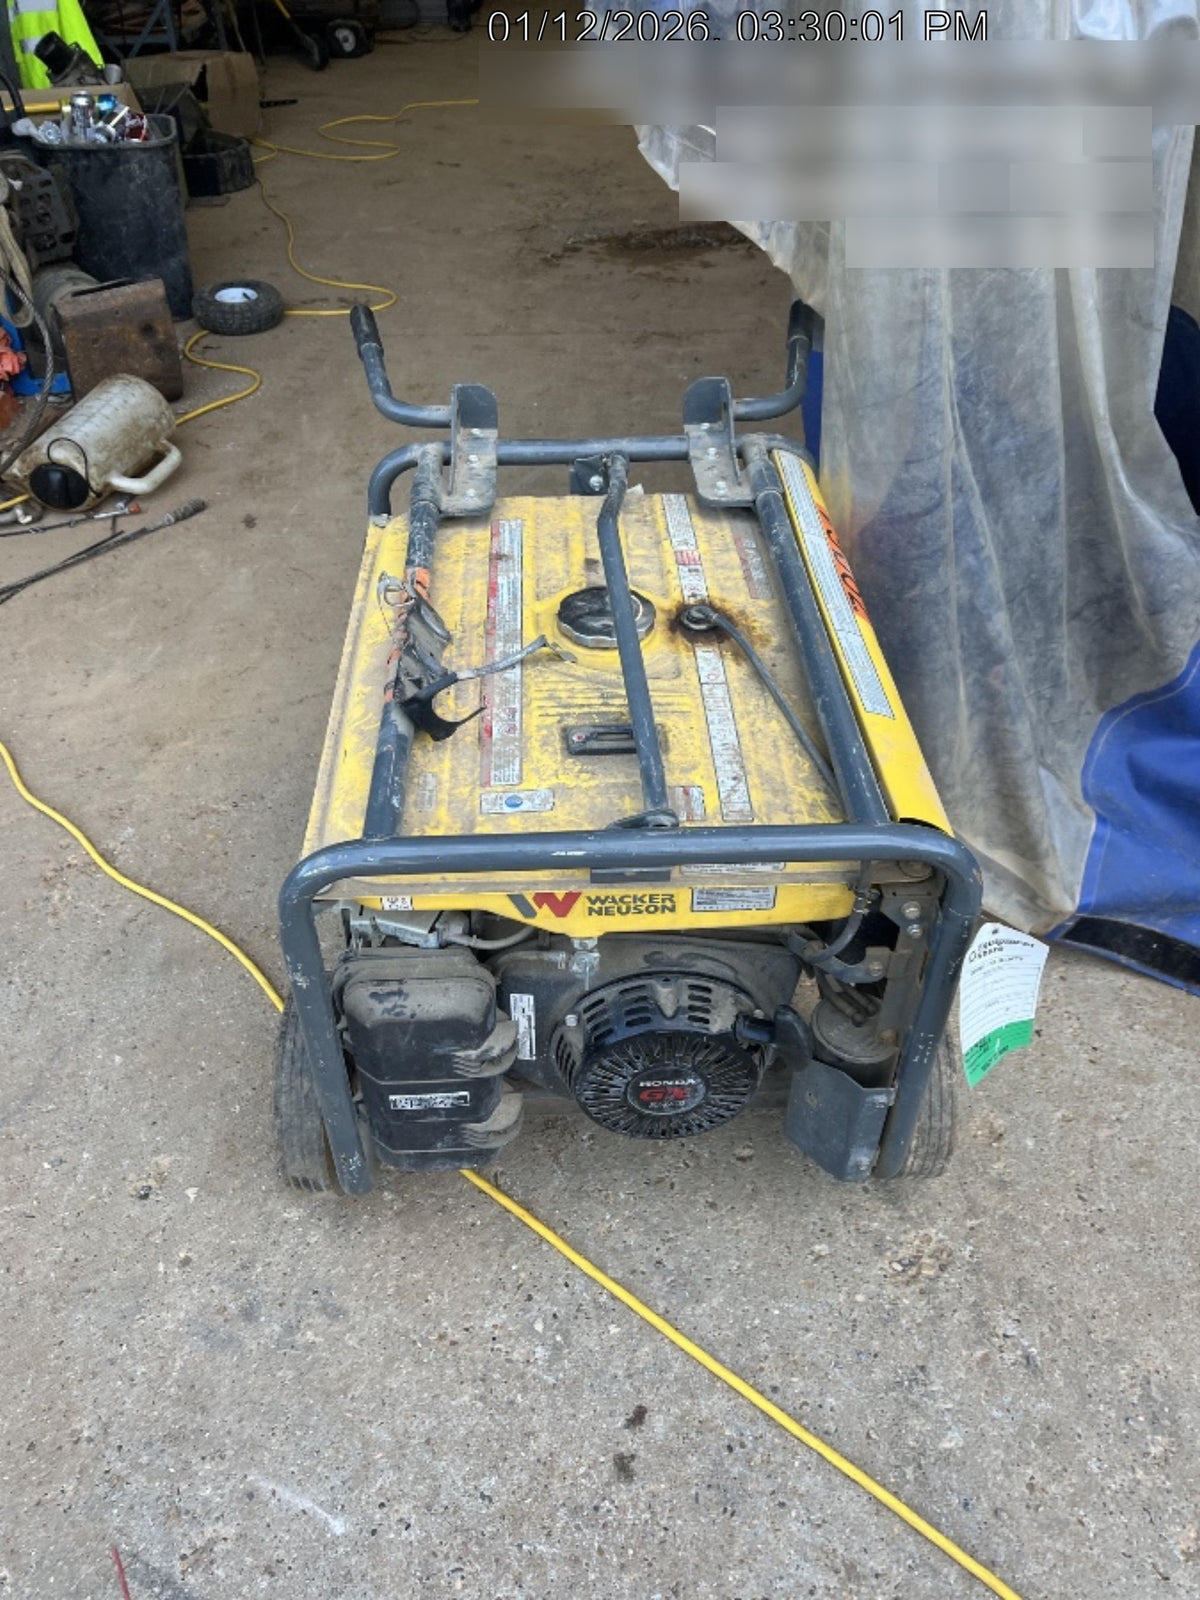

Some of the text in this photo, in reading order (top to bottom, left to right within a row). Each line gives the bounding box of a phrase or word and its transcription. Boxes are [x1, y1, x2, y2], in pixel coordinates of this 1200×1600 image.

[585, 893, 676, 905] WACKER
[587, 904, 676, 916] NEUSON
[639, 1079, 696, 1088] HONDA
